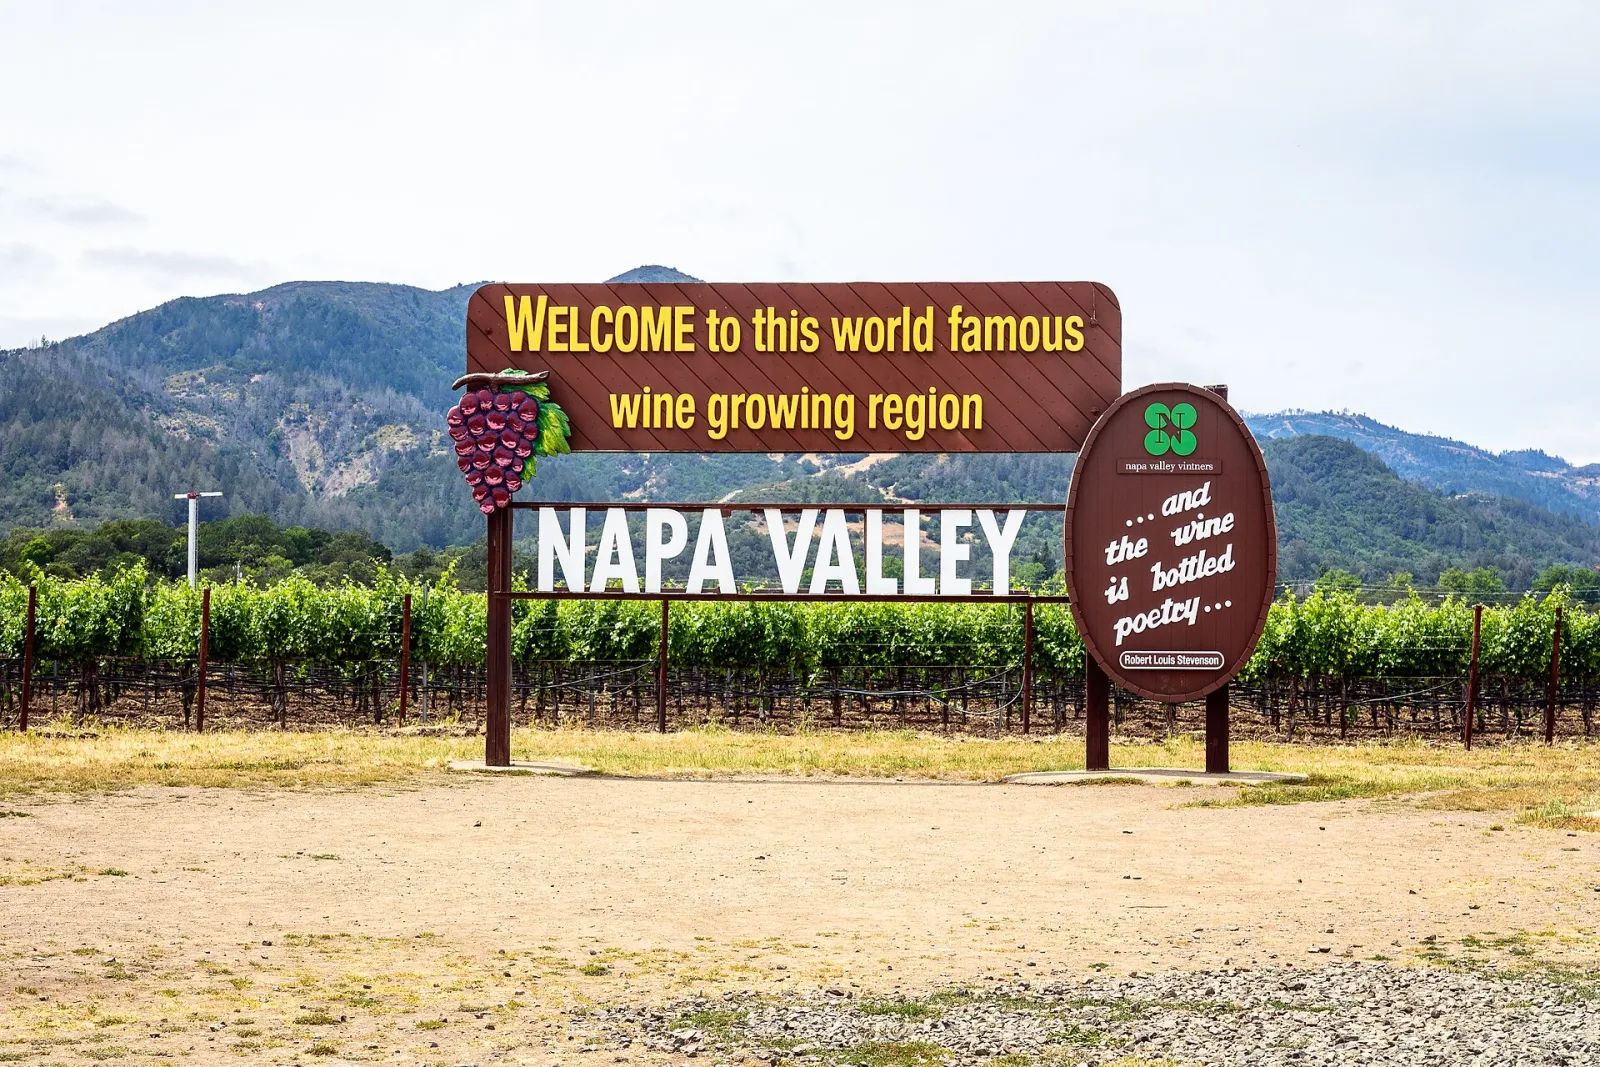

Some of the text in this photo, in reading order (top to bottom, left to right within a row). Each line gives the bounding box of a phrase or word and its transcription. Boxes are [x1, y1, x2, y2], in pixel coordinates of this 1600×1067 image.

[503, 295, 1084, 353] WELCOME to this world famous
[610, 386, 983, 440] wine growing region
[1125, 460, 1214, 472] napa valley vintners
[537, 507, 1028, 595] NAPA VALLEY
[1104, 512, 1235, 566] the wine
[1104, 543, 1236, 605] is bottled
[1124, 654, 1219, 665] Robert Louis Stevenson
